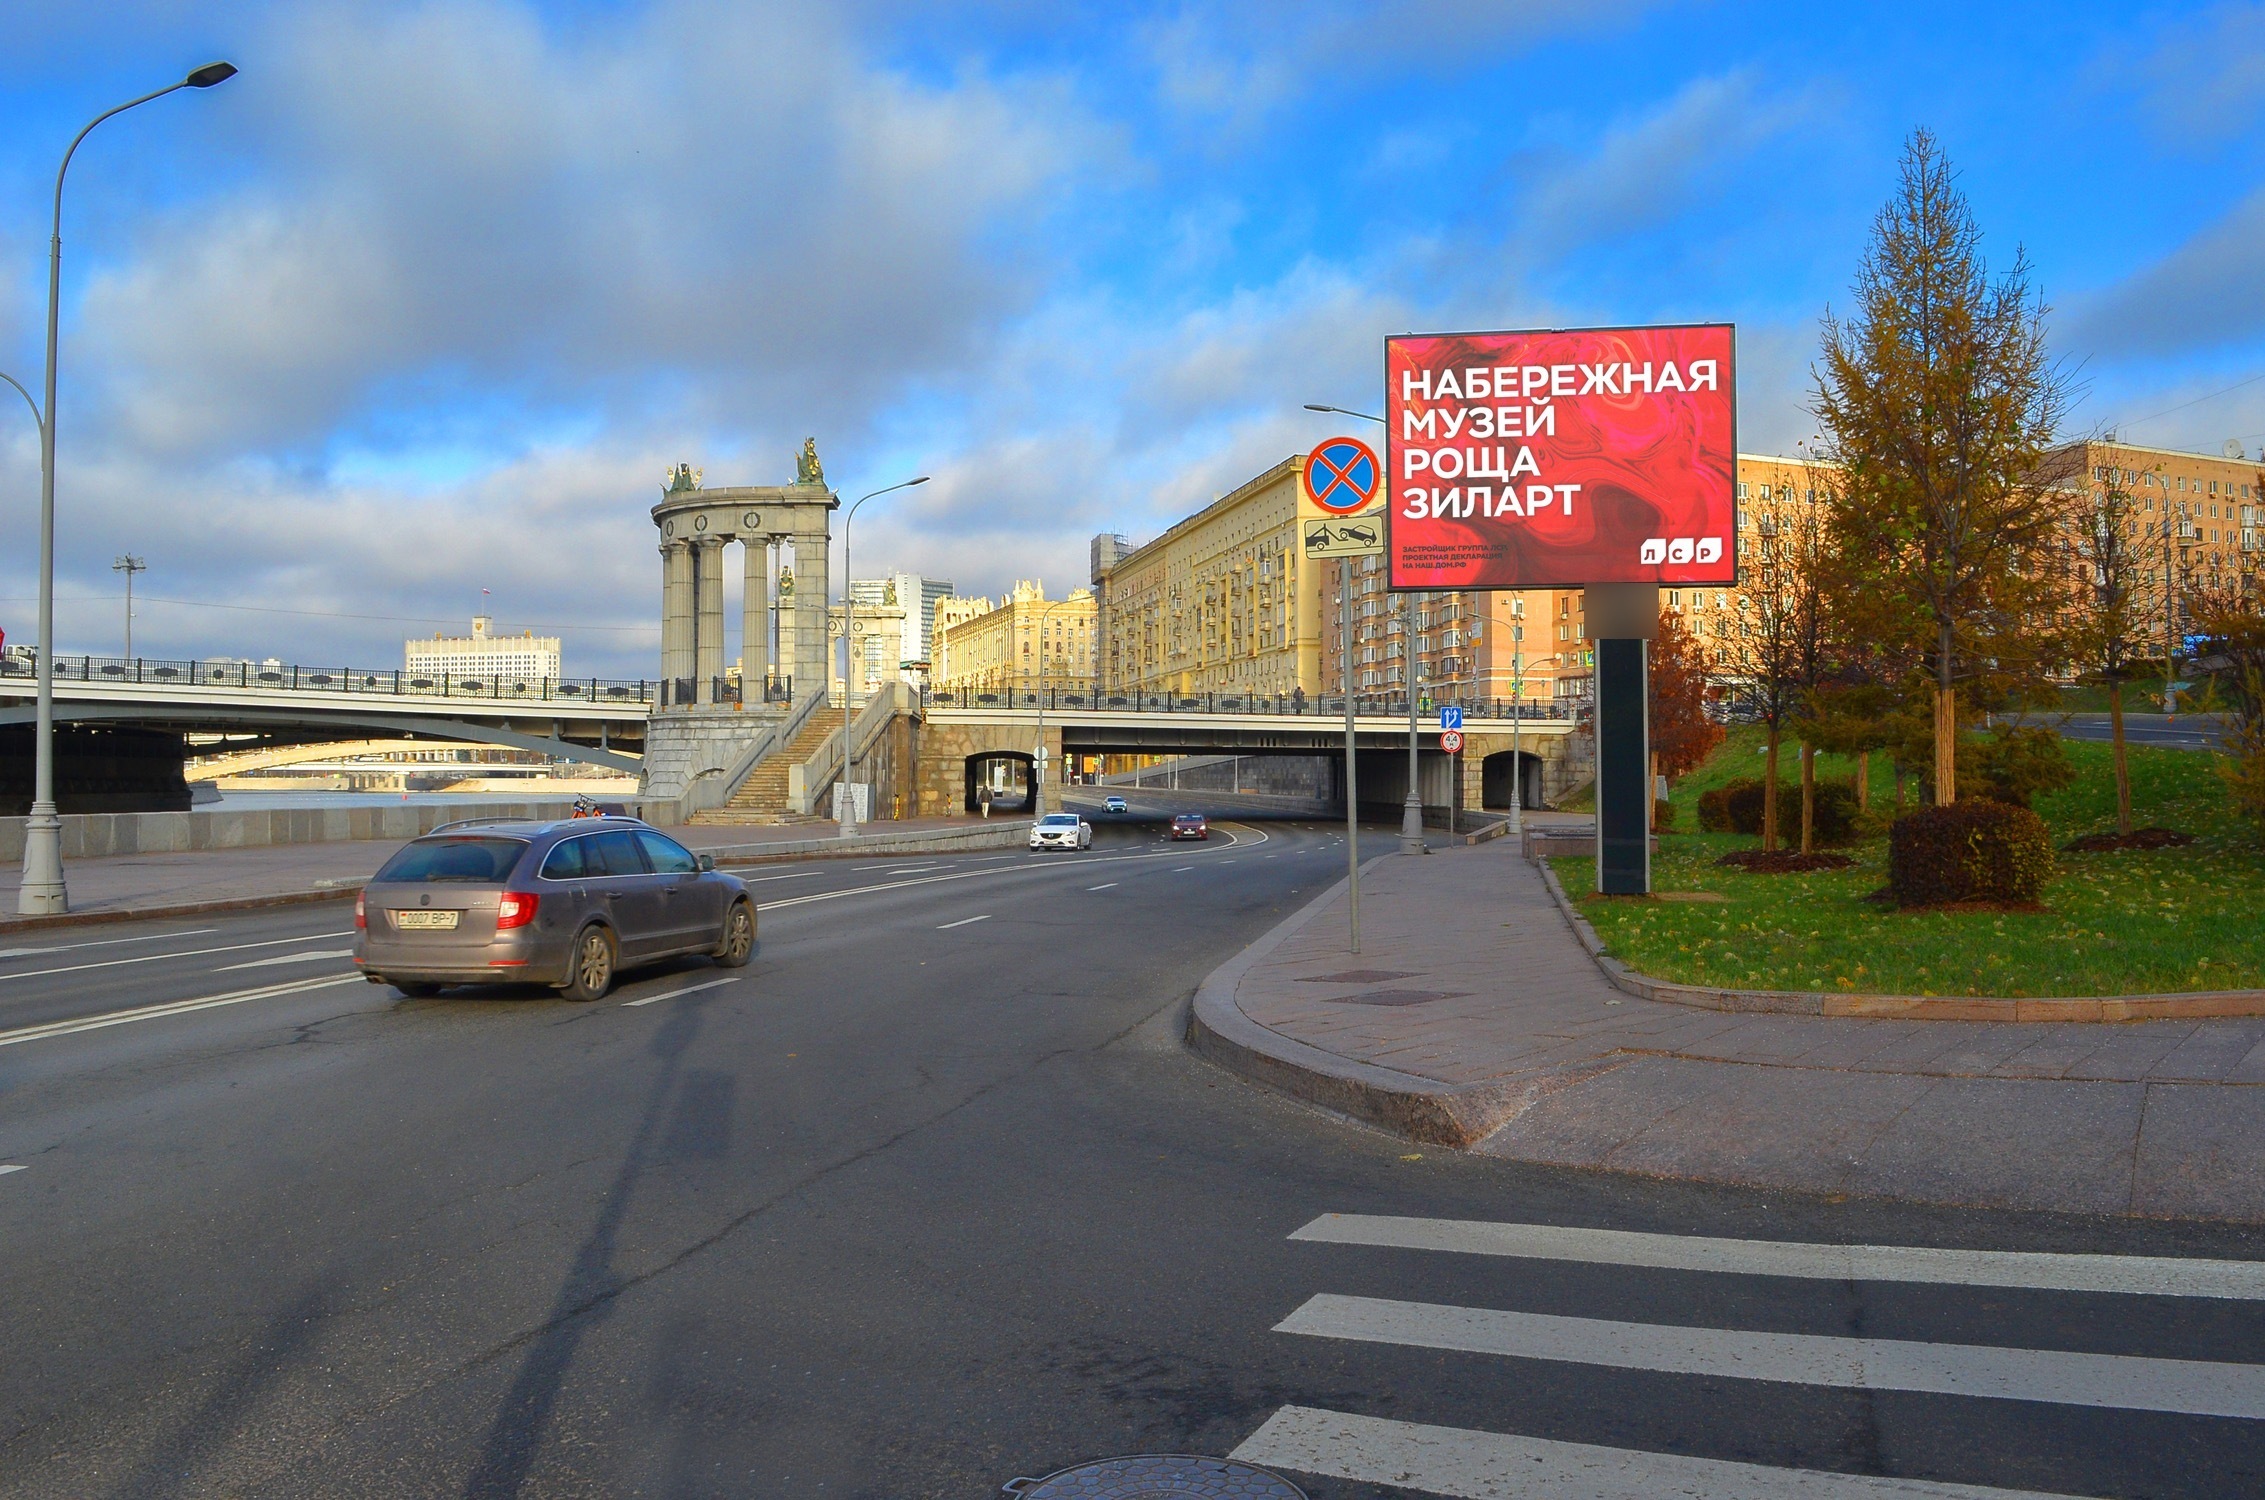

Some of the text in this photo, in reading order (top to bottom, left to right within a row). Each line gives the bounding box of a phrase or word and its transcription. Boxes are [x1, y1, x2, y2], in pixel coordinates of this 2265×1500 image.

[1402, 360, 1718, 402] НАБЕРЕЖНАЯ
[1403, 396, 1556, 441] МУЗЕЙ
[1404, 446, 1542, 483] РОЩА
[1402, 484, 1582, 520] ЗИЛАРТ
[1402, 545, 1456, 553] ЗАСТРОЙЩИК
[1450, 553, 1503, 561] ДЕКЛАРАЦИЯ
